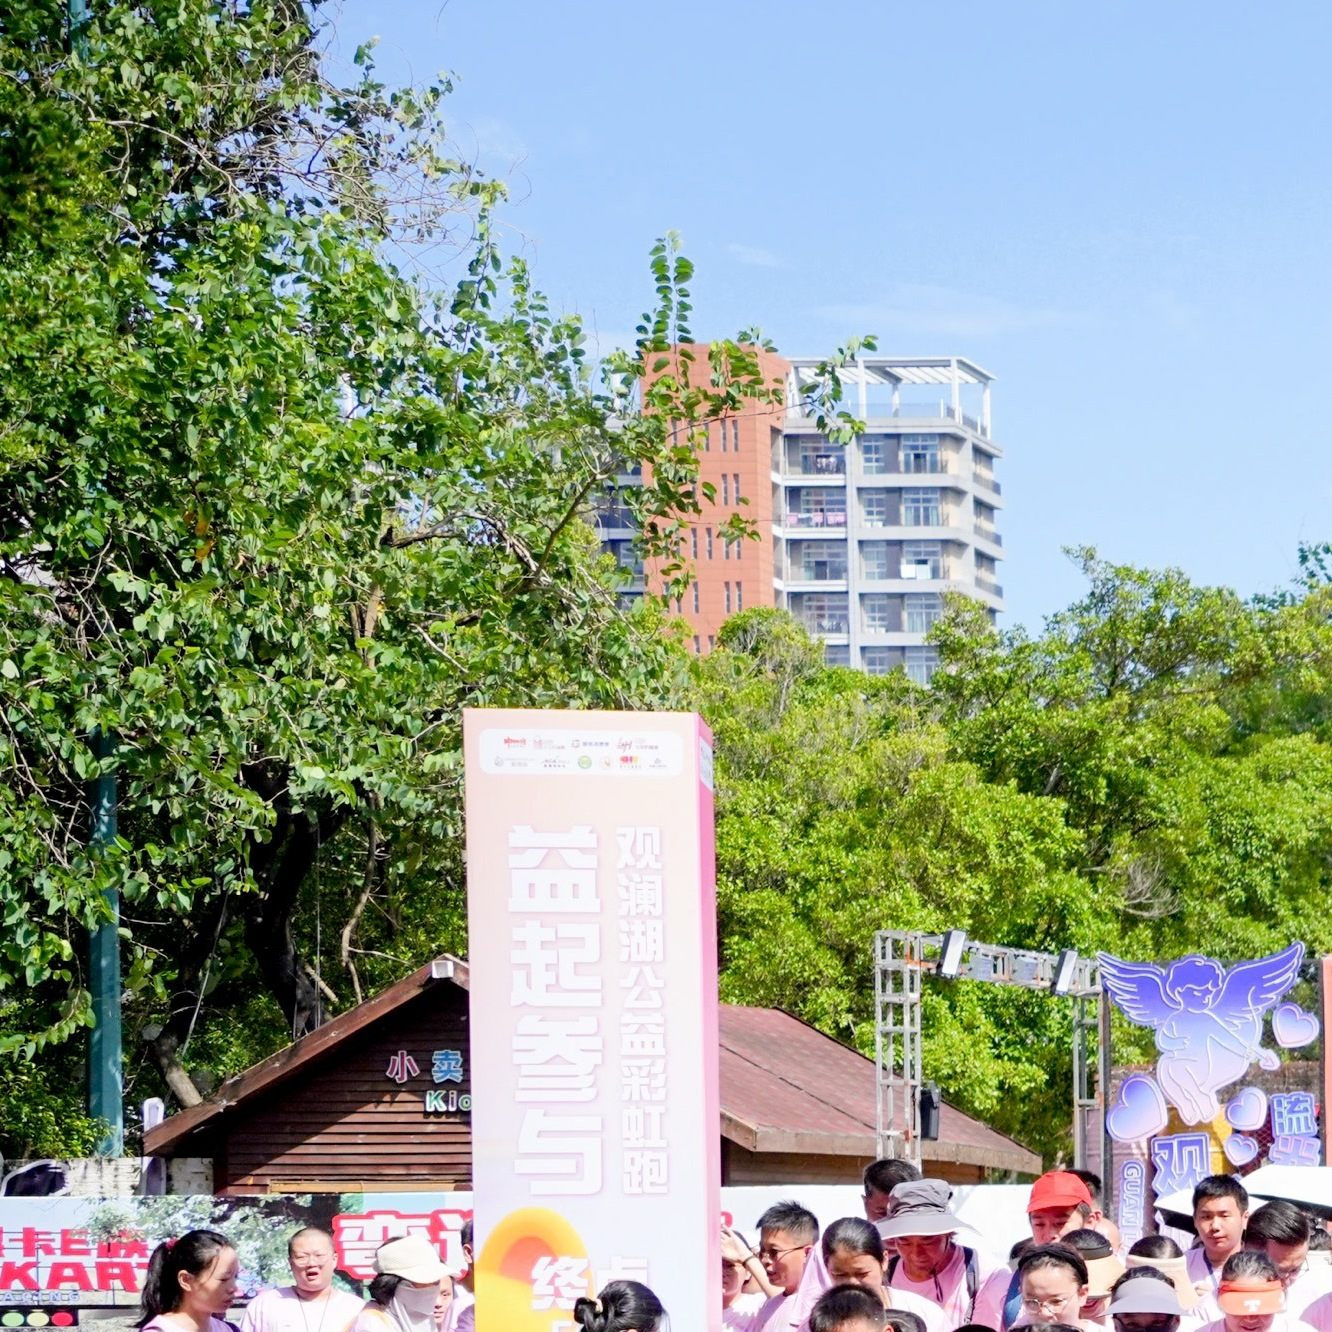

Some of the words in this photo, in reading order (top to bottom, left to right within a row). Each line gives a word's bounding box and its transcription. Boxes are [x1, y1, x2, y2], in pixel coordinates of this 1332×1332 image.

[386, 1050, 463, 1083] 小卖
[507, 824, 604, 1195] 益起参与
[616, 826, 669, 1195] 观澜湖公益彩虹跑
